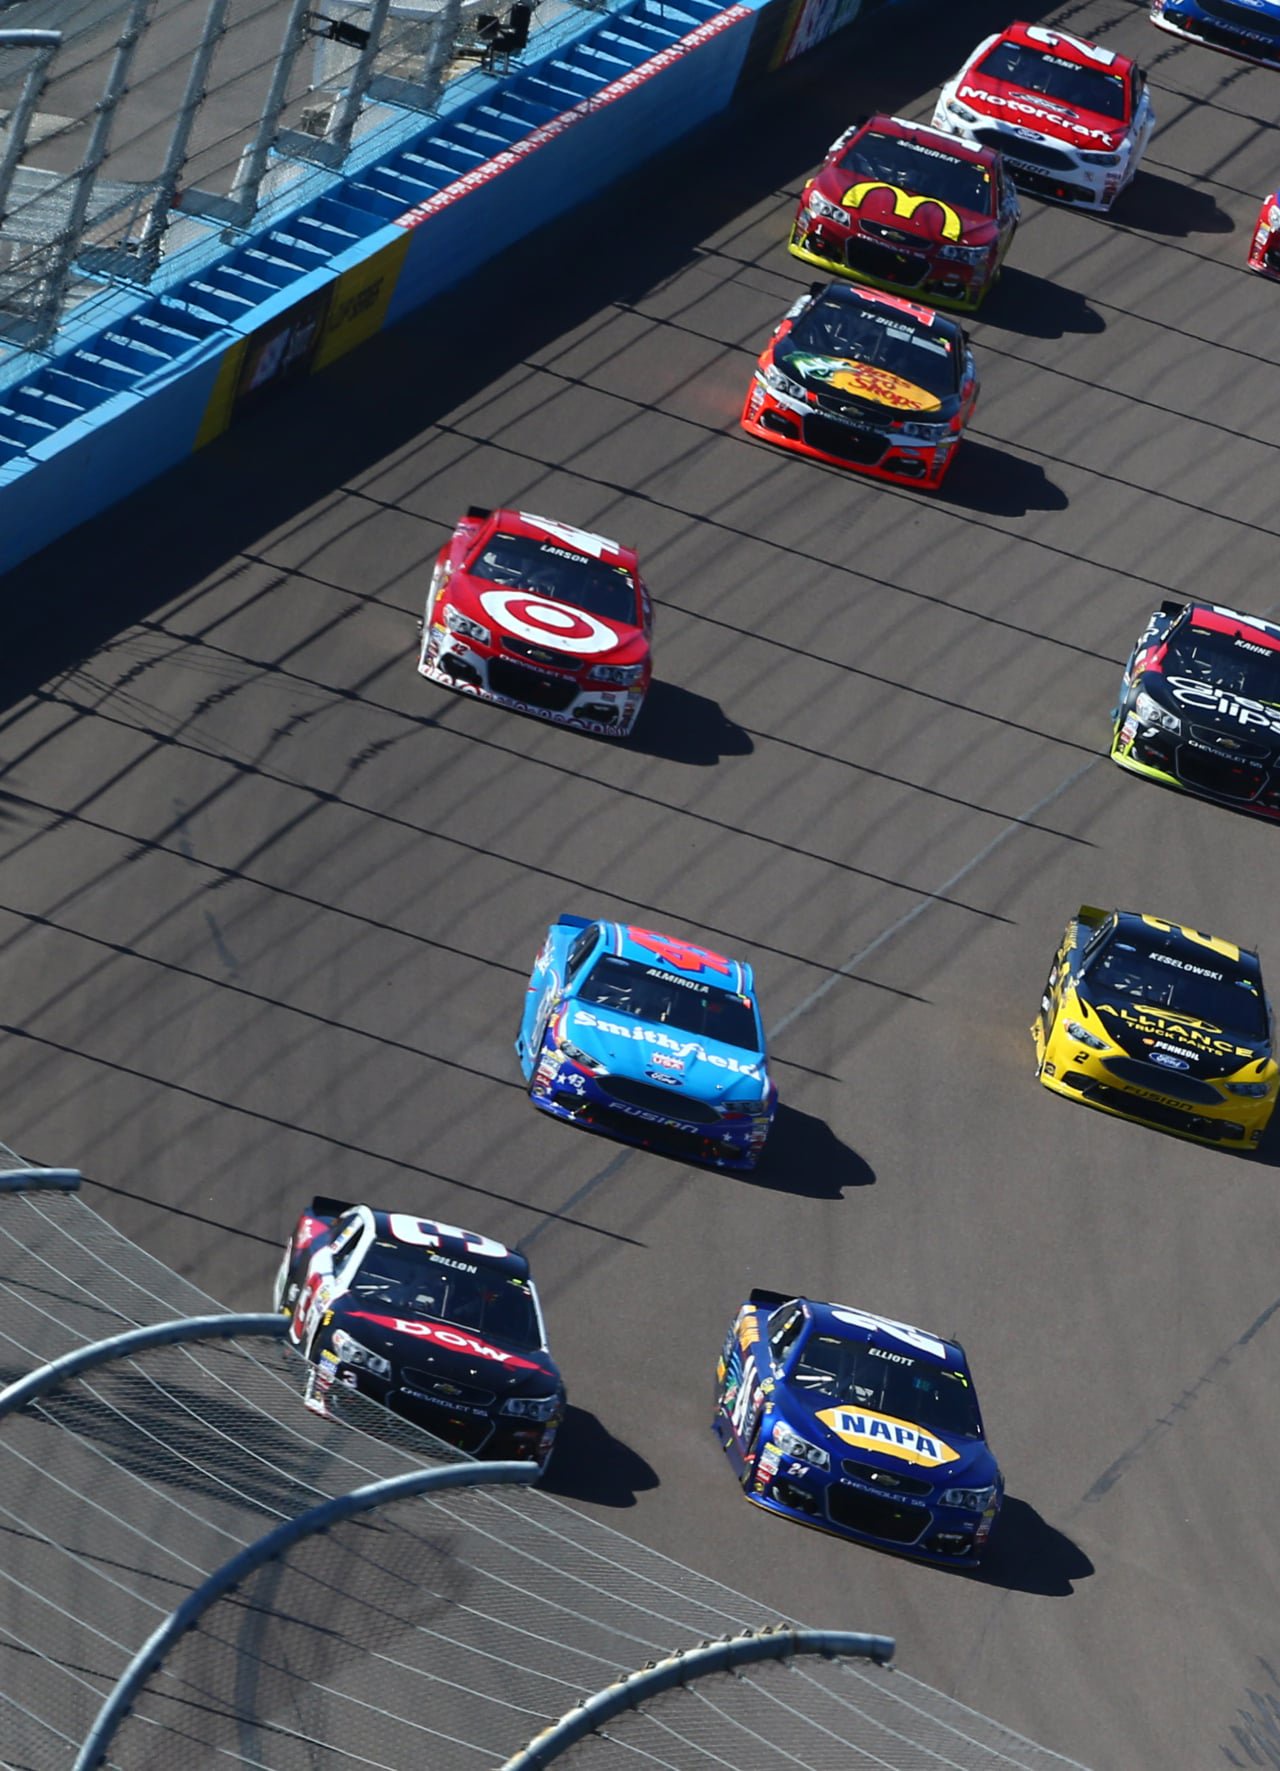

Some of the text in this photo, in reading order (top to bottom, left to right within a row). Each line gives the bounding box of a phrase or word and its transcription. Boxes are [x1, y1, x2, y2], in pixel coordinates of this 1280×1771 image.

[1042, 55, 1082, 71] BLANEY
[959, 86, 1113, 147] Motorcraft
[860, 311, 916, 334] TY DILLON
[848, 377, 922, 411] Shops
[540, 544, 589, 564] LARSON
[451, 643, 468, 655] 42
[1234, 639, 1273, 657] KAHNE
[1142, 728, 1159, 738] 5
[1188, 739, 1246, 764] CHEVROLET
[1149, 952, 1224, 981] KESELOWSKI
[646, 967, 710, 994] ALMIROLA
[1095, 1004, 1254, 1058] ALLIANCE
[1126, 1021, 1224, 1057] TRUCK PARTS
[573, 1009, 762, 1081] Smithfield
[1154, 1041, 1200, 1061] PENNZOIL
[1073, 1051, 1089, 1064] 2
[1151, 1053, 1188, 1070] Ford
[567, 1073, 586, 1088] 43
[649, 1071, 679, 1085] Ford
[389, 1213, 508, 1258] 3
[430, 1254, 478, 1274] DILLON
[393, 1318, 513, 1362] DOW
[868, 1348, 915, 1367] ELLIOTT
[400, 1386, 470, 1413] CHEVROLET
[841, 1413, 937, 1459] NAPA
[787, 1463, 810, 1477] 24
[840, 1477, 907, 1503] CHEVROLET
